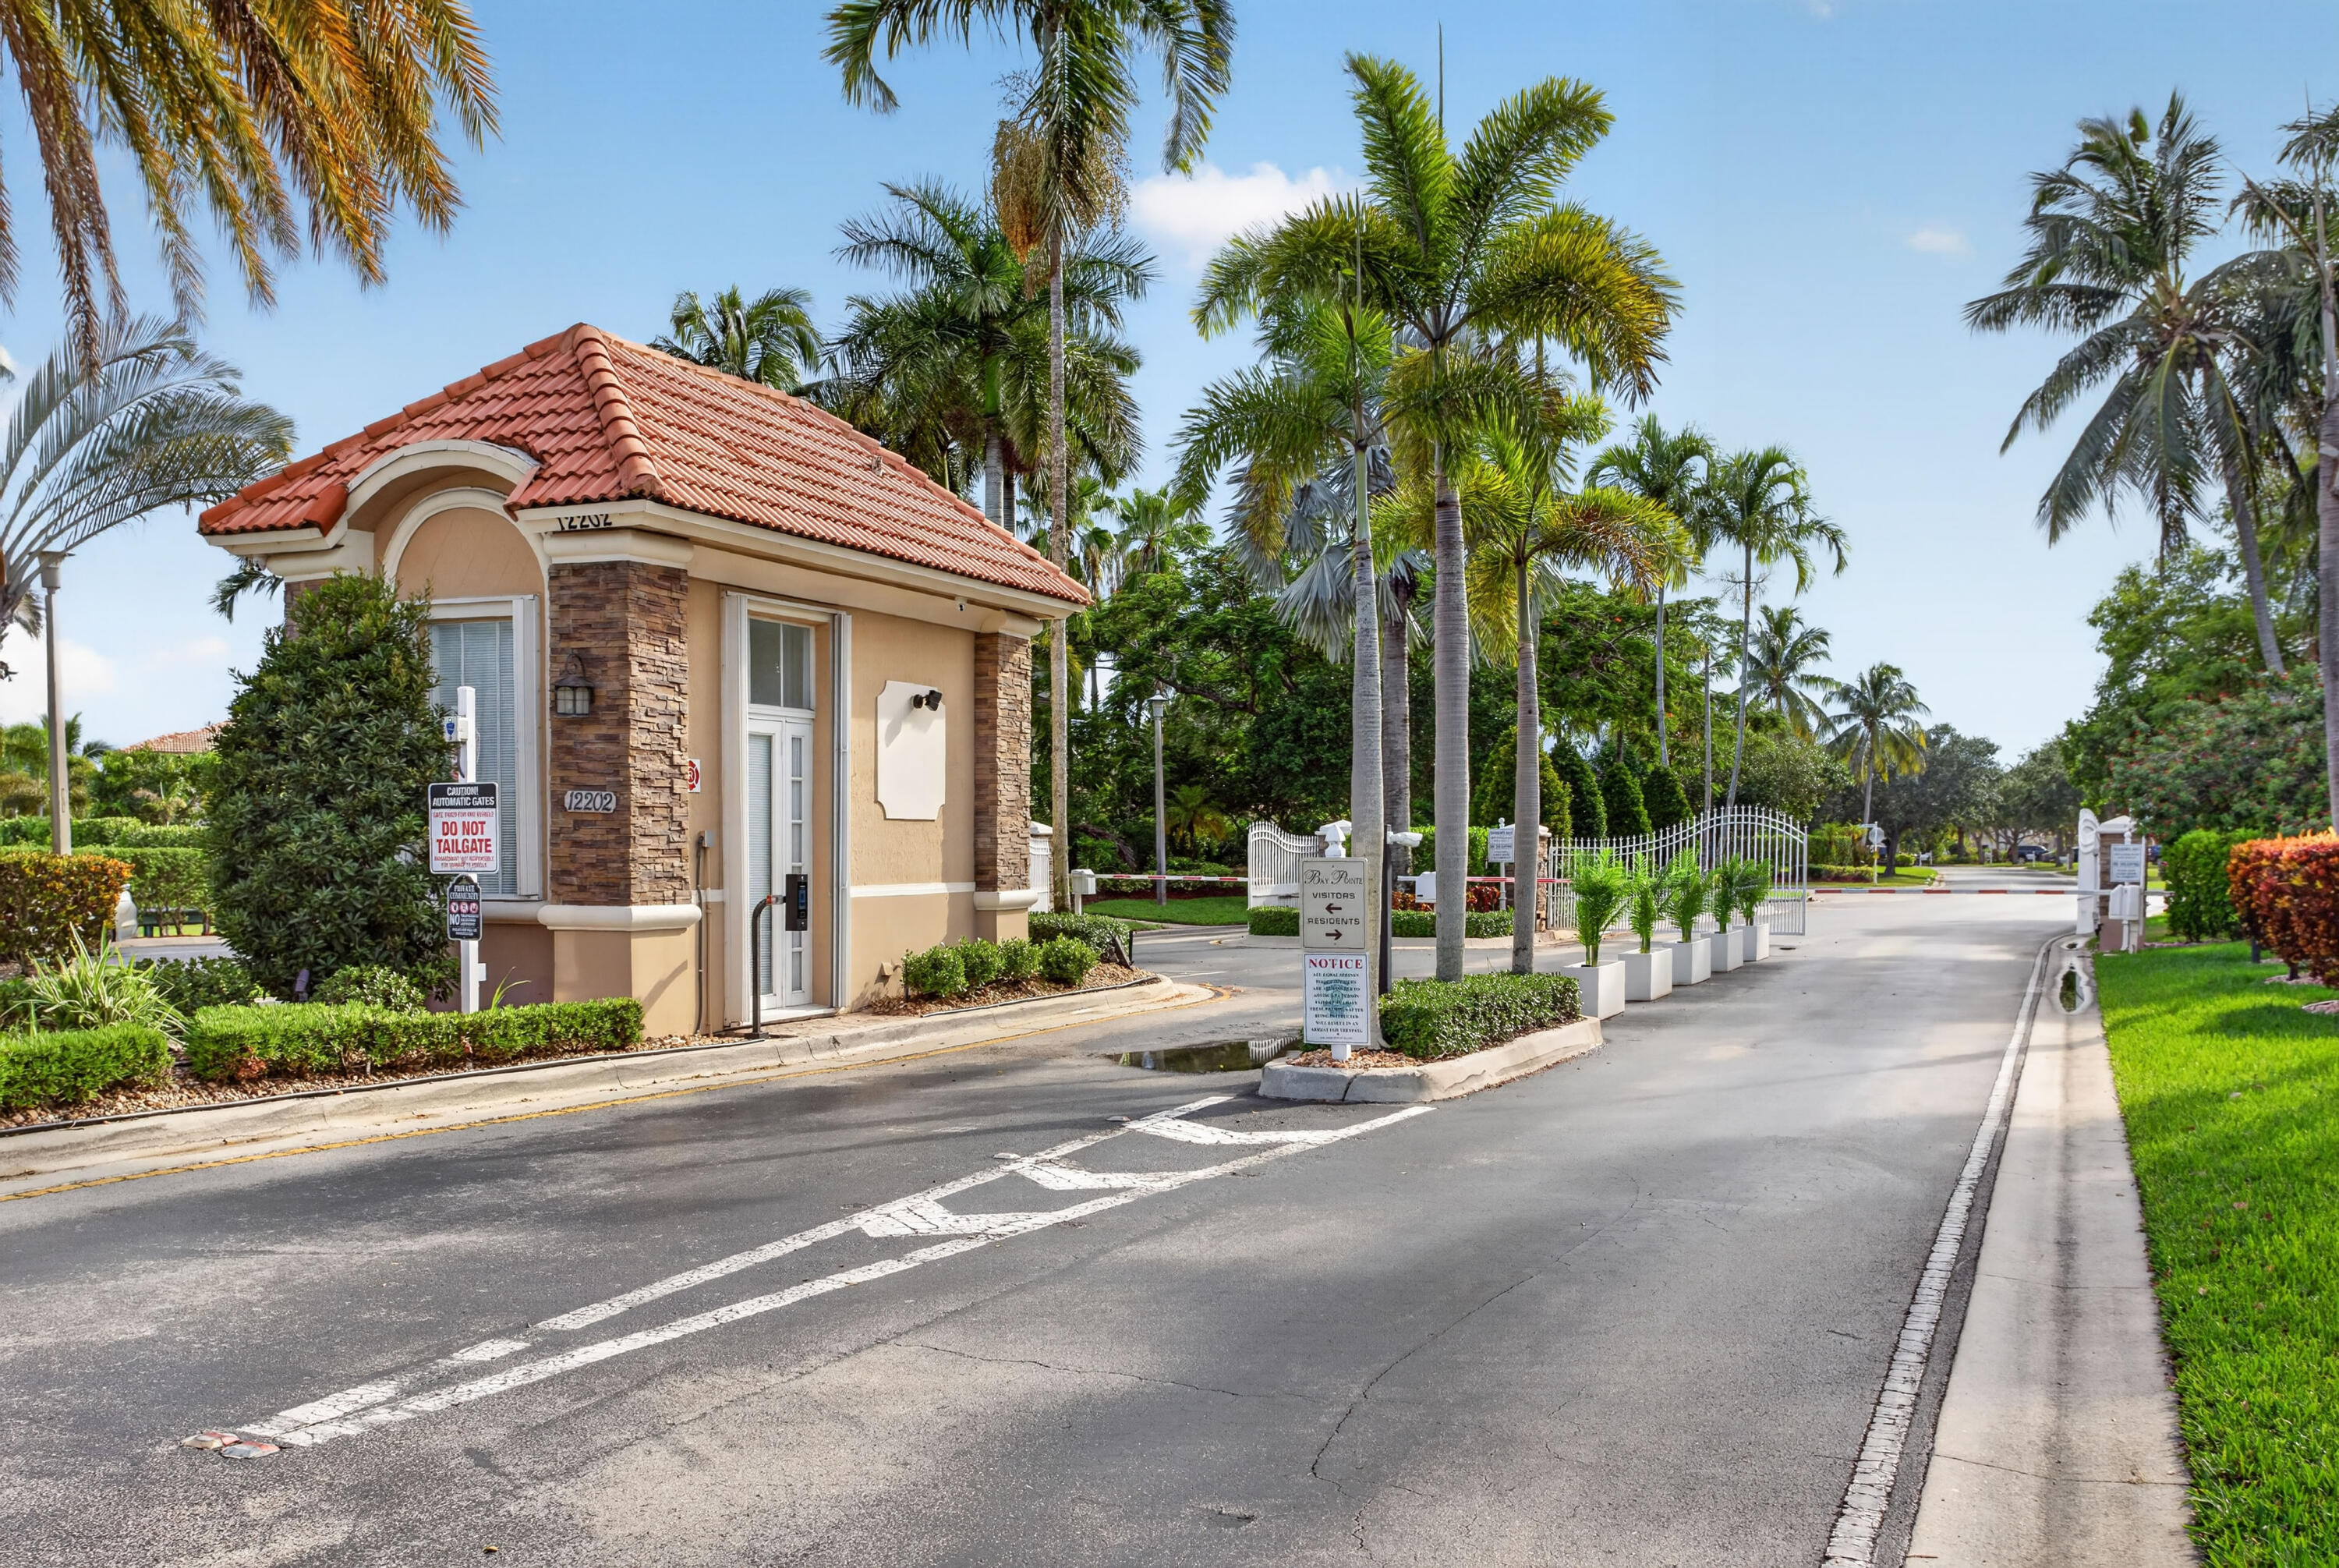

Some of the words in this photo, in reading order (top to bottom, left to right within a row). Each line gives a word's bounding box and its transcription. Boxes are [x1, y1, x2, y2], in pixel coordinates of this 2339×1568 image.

[556, 514, 612, 530] 12202
[447, 786, 479, 796] CAUTION!
[433, 798, 472, 806] AUTOMATIC
[472, 797, 494, 806] GATES
[568, 791, 613, 811] 12202
[442, 821, 458, 836] DO
[462, 820, 486, 836] NOT
[437, 838, 492, 854] TAILGATE
[449, 914, 460, 926] NO
[1309, 958, 1363, 969] NOTICE
